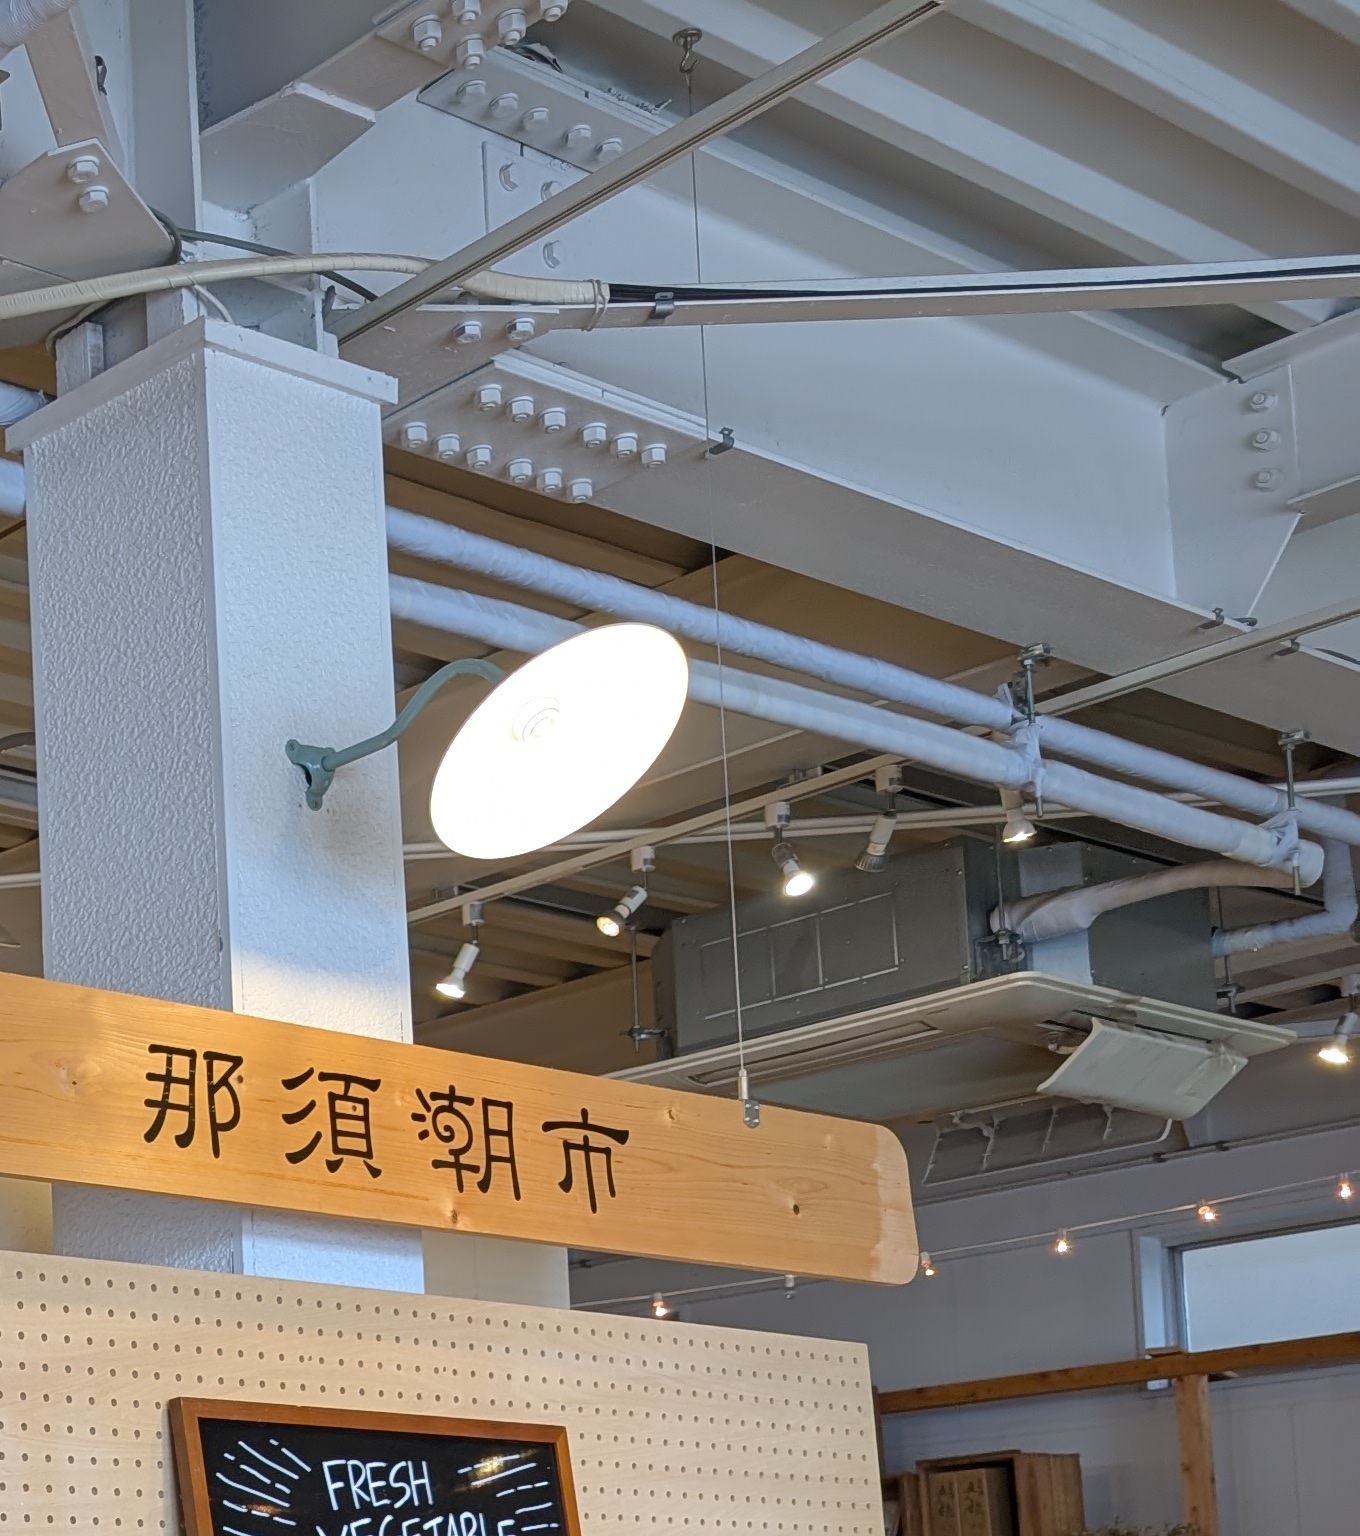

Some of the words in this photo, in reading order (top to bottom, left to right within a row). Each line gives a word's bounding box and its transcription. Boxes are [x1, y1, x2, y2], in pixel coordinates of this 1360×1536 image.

[143, 1043, 630, 1214] 那須潮市
[321, 1458, 434, 1510] FRESH
